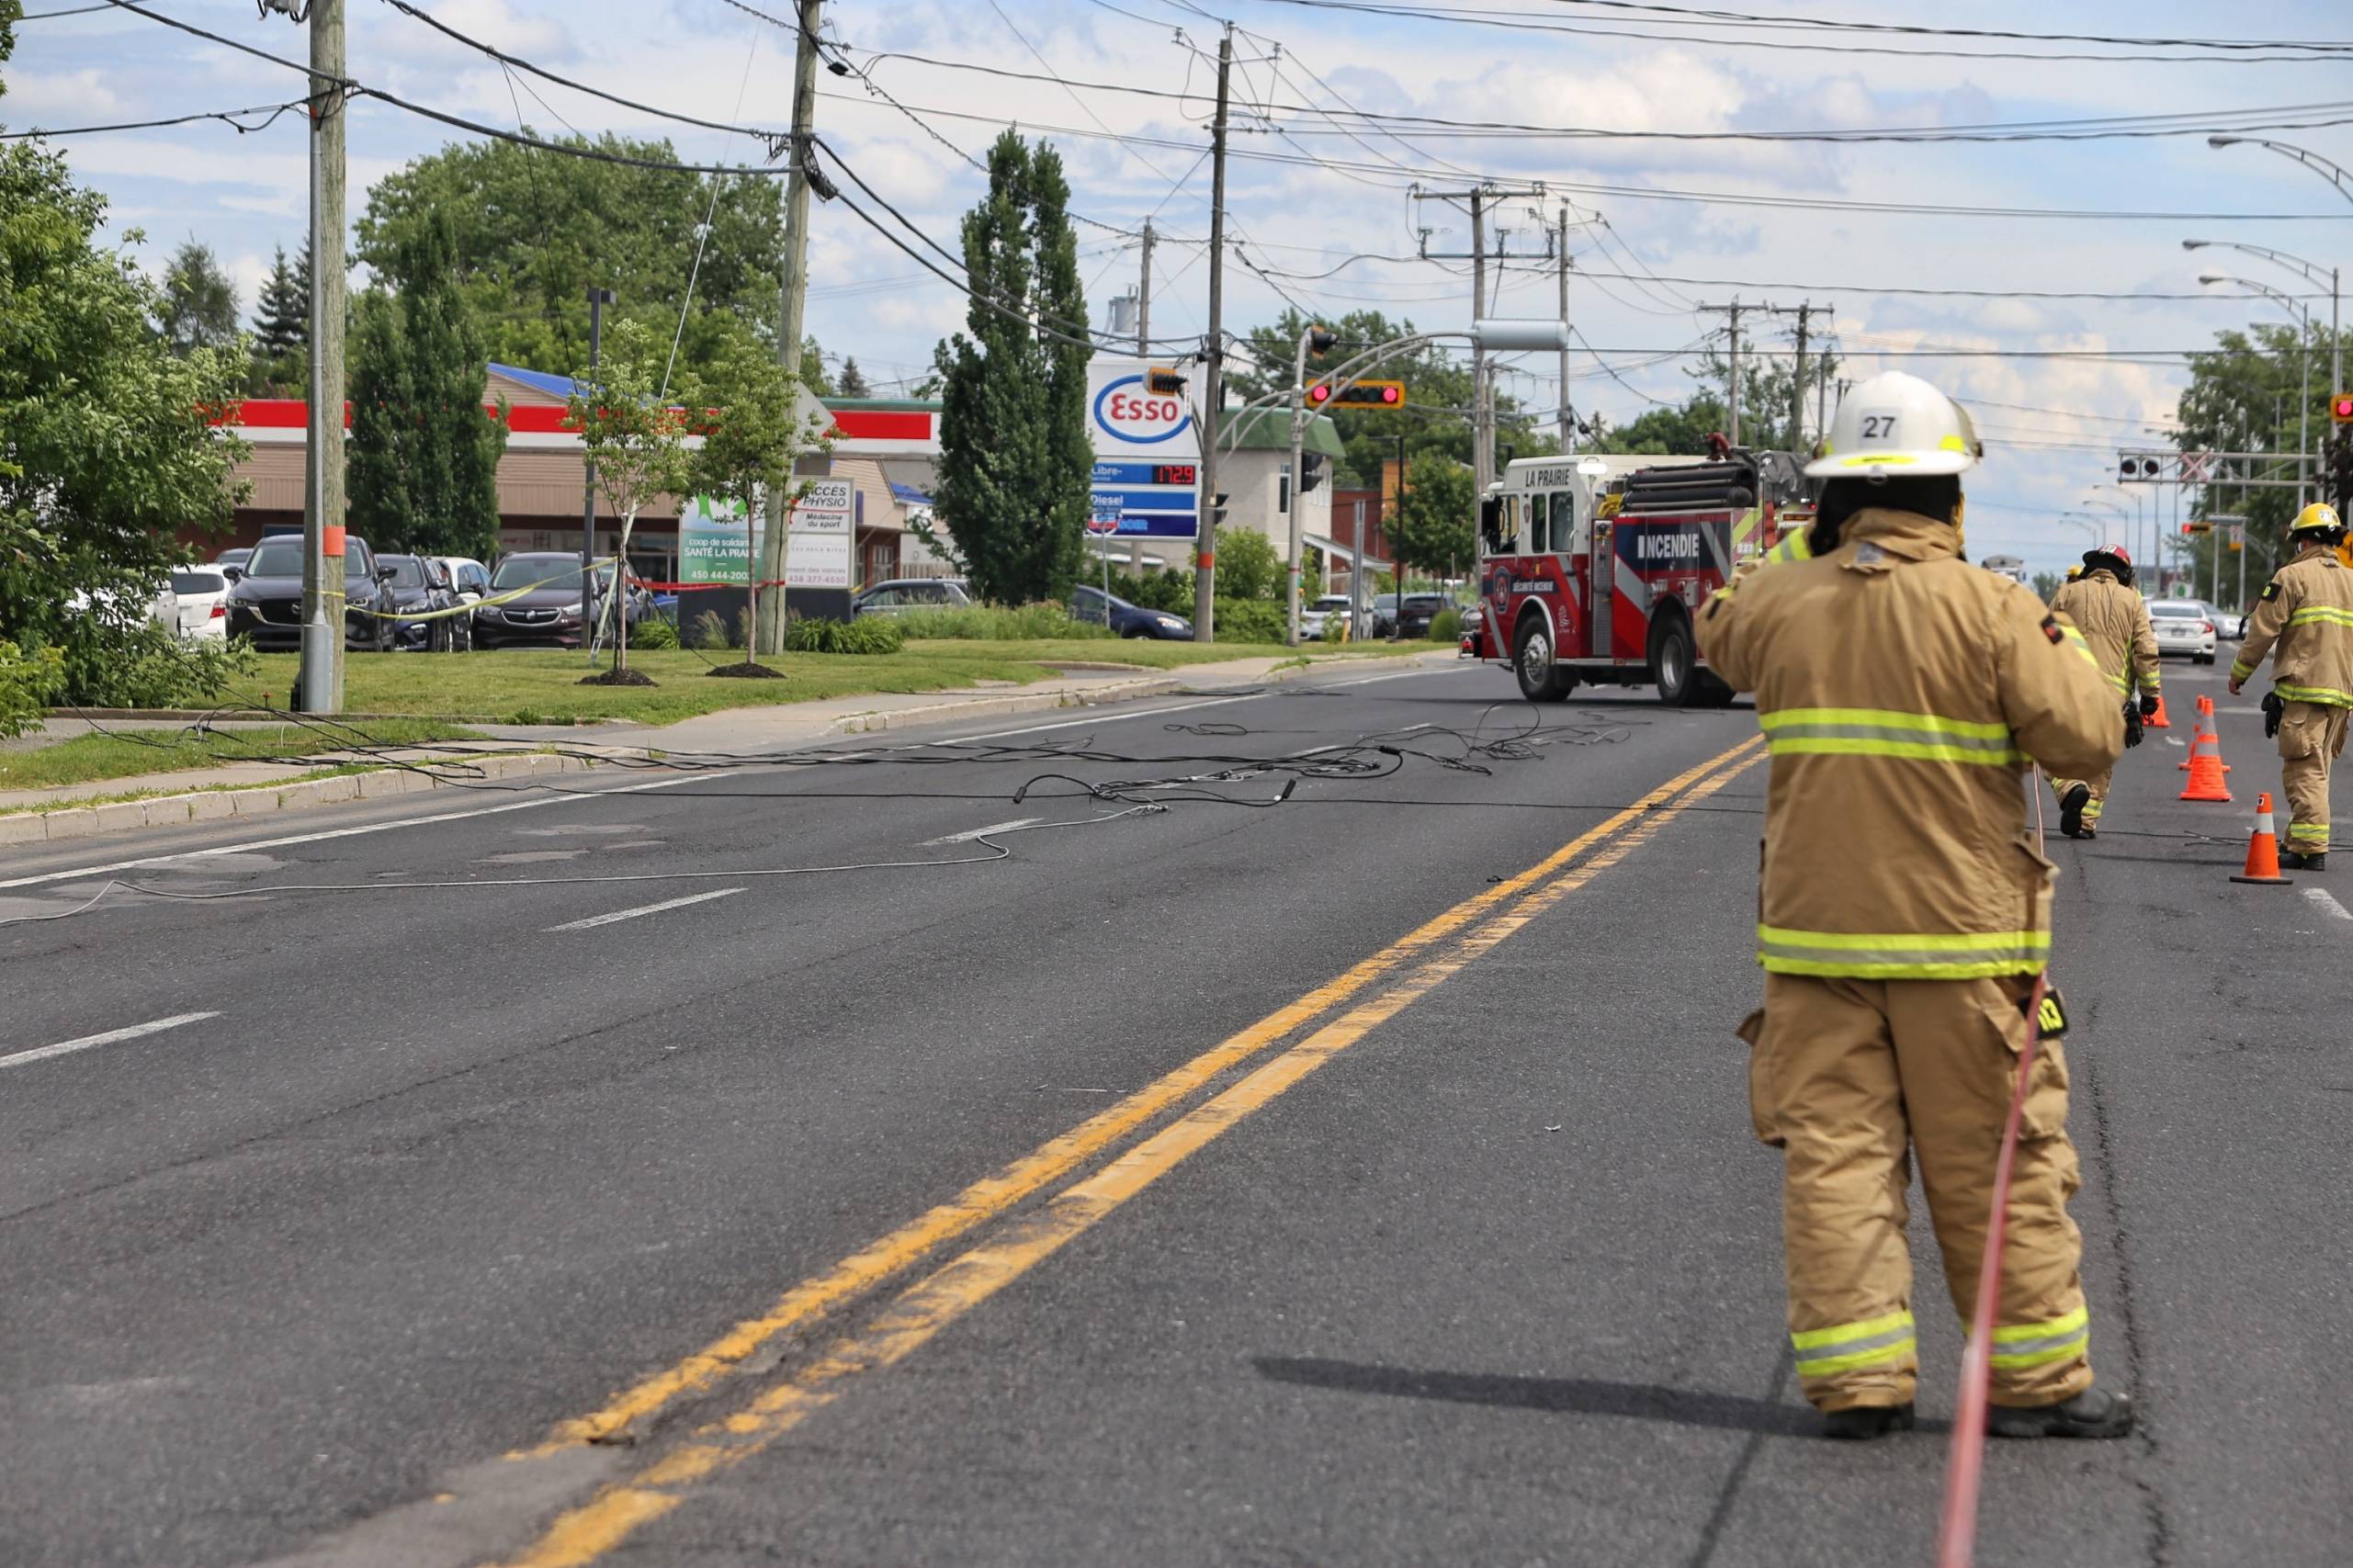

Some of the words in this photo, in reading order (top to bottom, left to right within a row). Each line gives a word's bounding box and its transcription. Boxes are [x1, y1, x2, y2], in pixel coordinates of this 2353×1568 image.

[1111, 392, 1178, 422] Esso
[1862, 416, 1896, 438] 27
[1159, 466, 1194, 483] 172.9
[1525, 469, 1535, 487] LA
[1537, 468, 1570, 486] PRAIRIE
[803, 496, 846, 507] PHYSIO
[689, 538, 709, 547] coop
[710, 536, 720, 546] de
[1637, 534, 1700, 558] INCENDIE
[684, 547, 713, 558] SANTÉ
[715, 548, 728, 558] LA
[691, 570, 708, 580] 450
